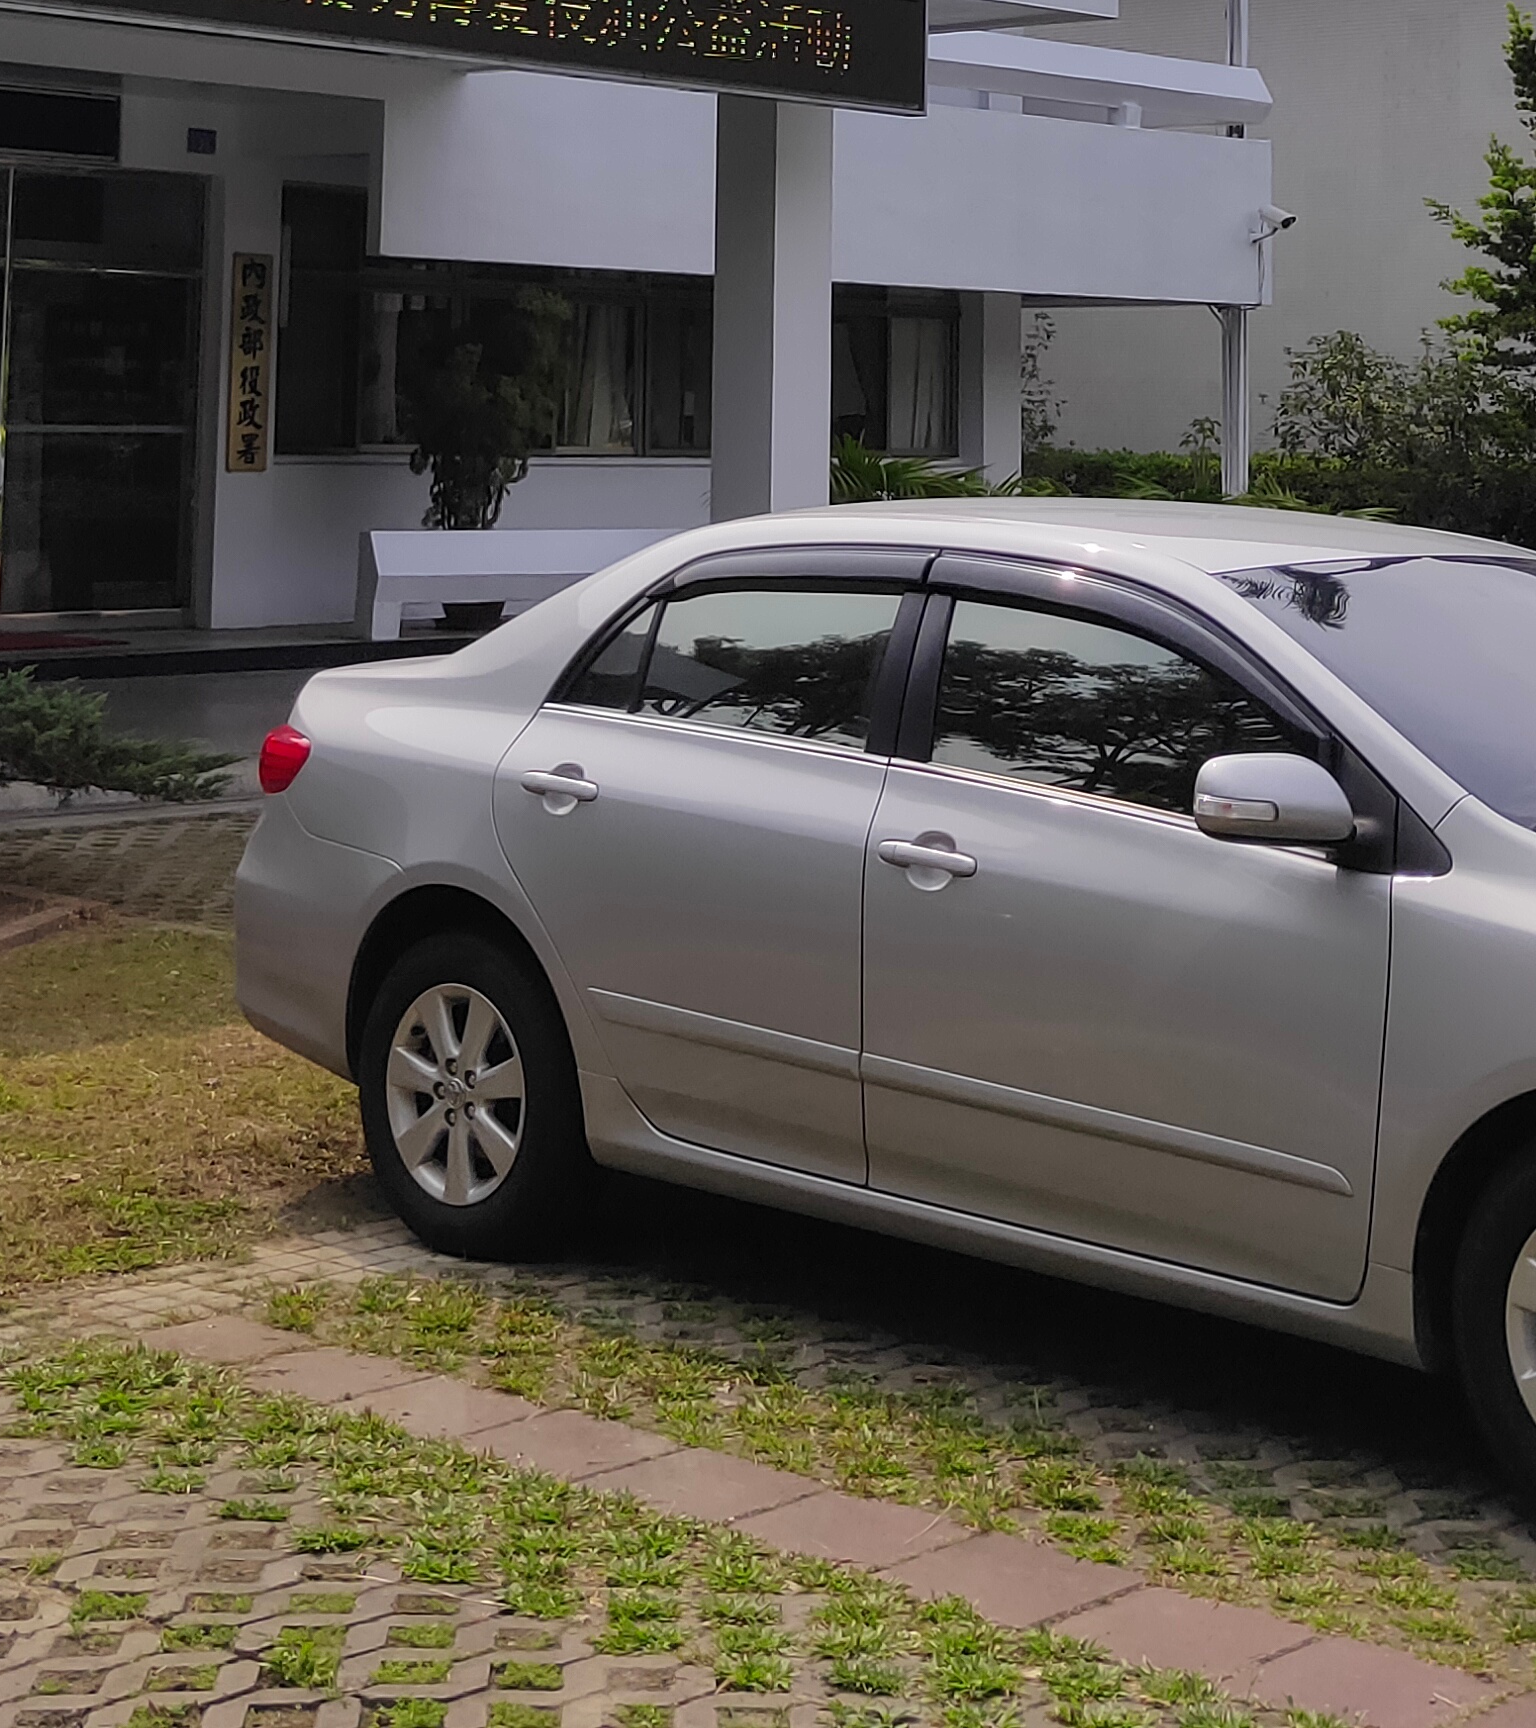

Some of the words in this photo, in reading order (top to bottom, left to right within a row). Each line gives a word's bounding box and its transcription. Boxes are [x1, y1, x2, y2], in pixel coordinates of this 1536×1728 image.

[236, 258, 267, 466] 內政部役政署
